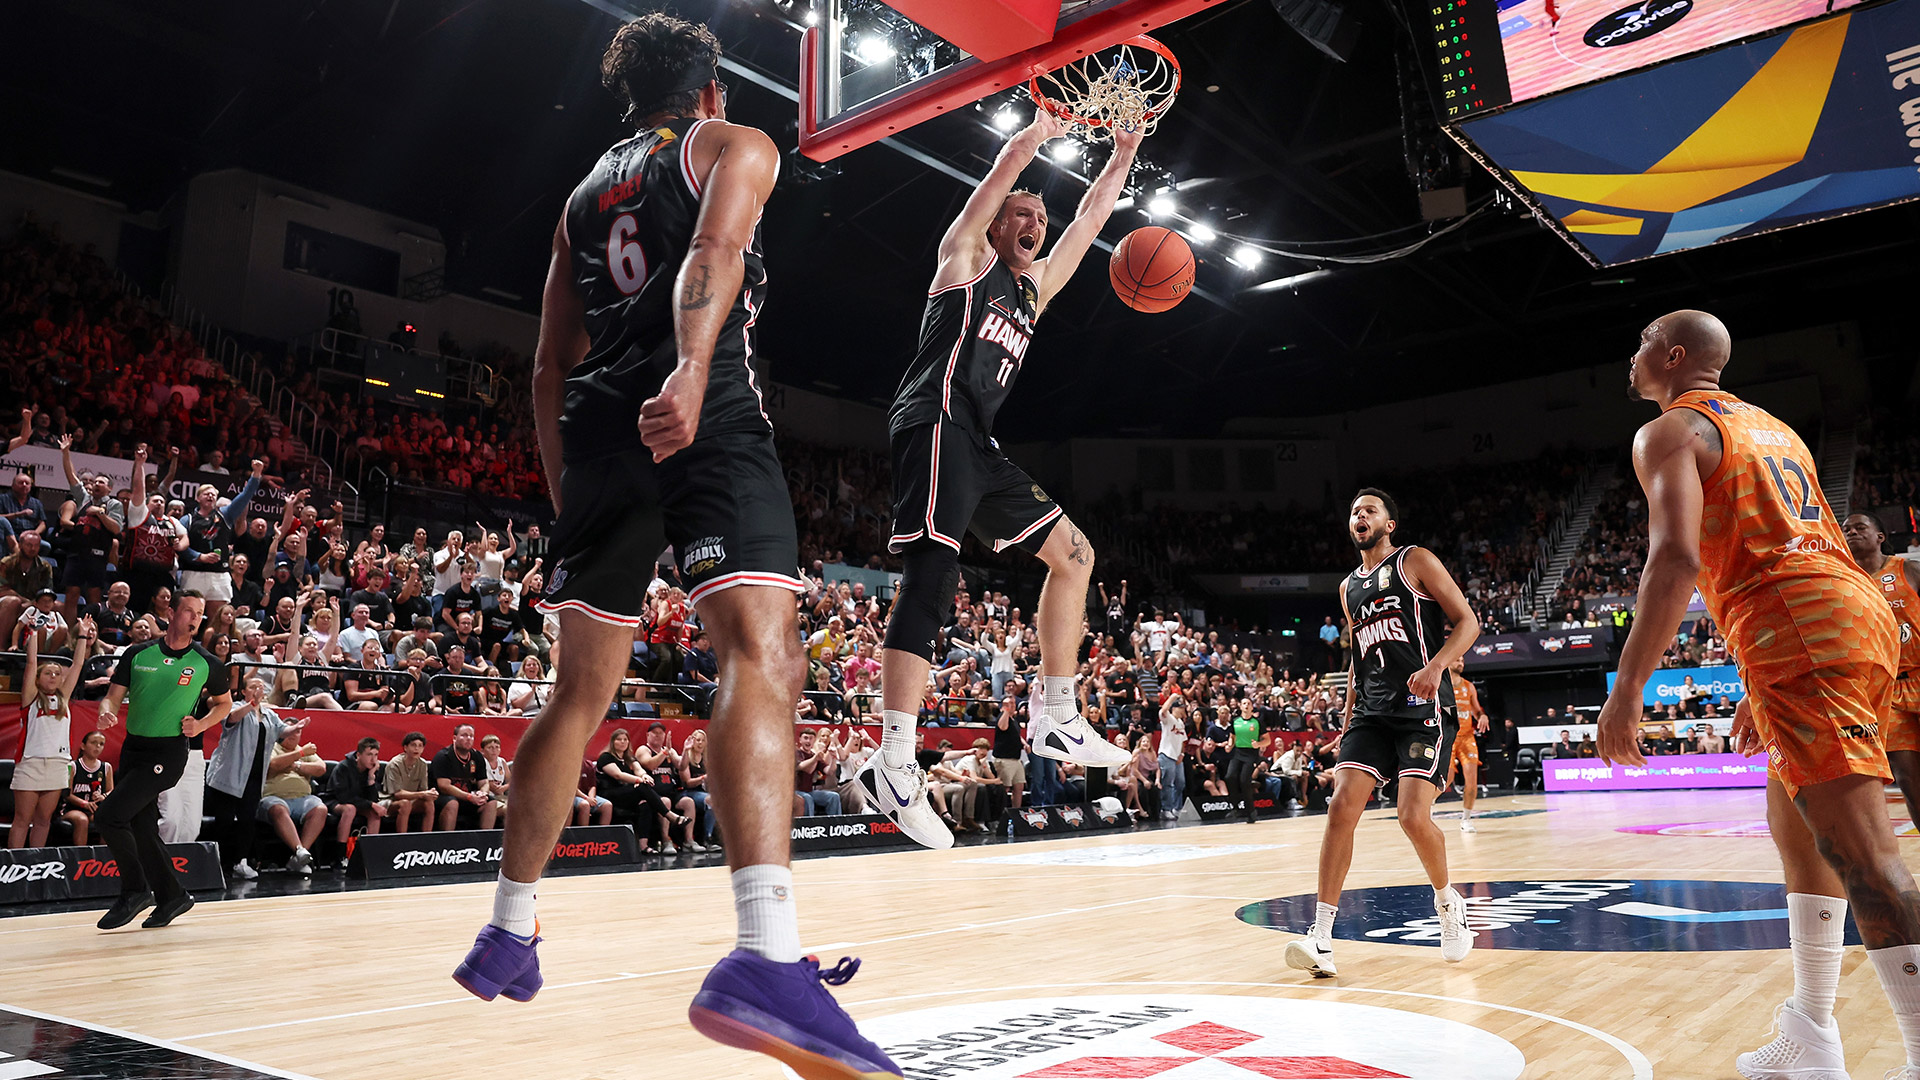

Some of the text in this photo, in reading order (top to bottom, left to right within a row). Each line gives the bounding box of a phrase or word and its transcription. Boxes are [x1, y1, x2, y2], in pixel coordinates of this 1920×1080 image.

[599, 173, 642, 213] HICKEY
[607, 212, 648, 296] 6
[978, 312, 1030, 368] HAW
[996, 357, 1014, 388] 11
[1276, 442, 1298, 462] 23
[1472, 433, 1494, 453] 24
[1763, 455, 1822, 523] 12
[685, 536, 724, 554] HEALTHY
[685, 544, 721, 569] DEADLY
[690, 559, 715, 578] KIDS
[1361, 595, 1401, 619] MCR
[1355, 616, 1410, 661] HAWKS
[1375, 647, 1385, 669] 1
[829, 823, 869, 837] LOUDER
[393, 848, 481, 870] STRONGER.
